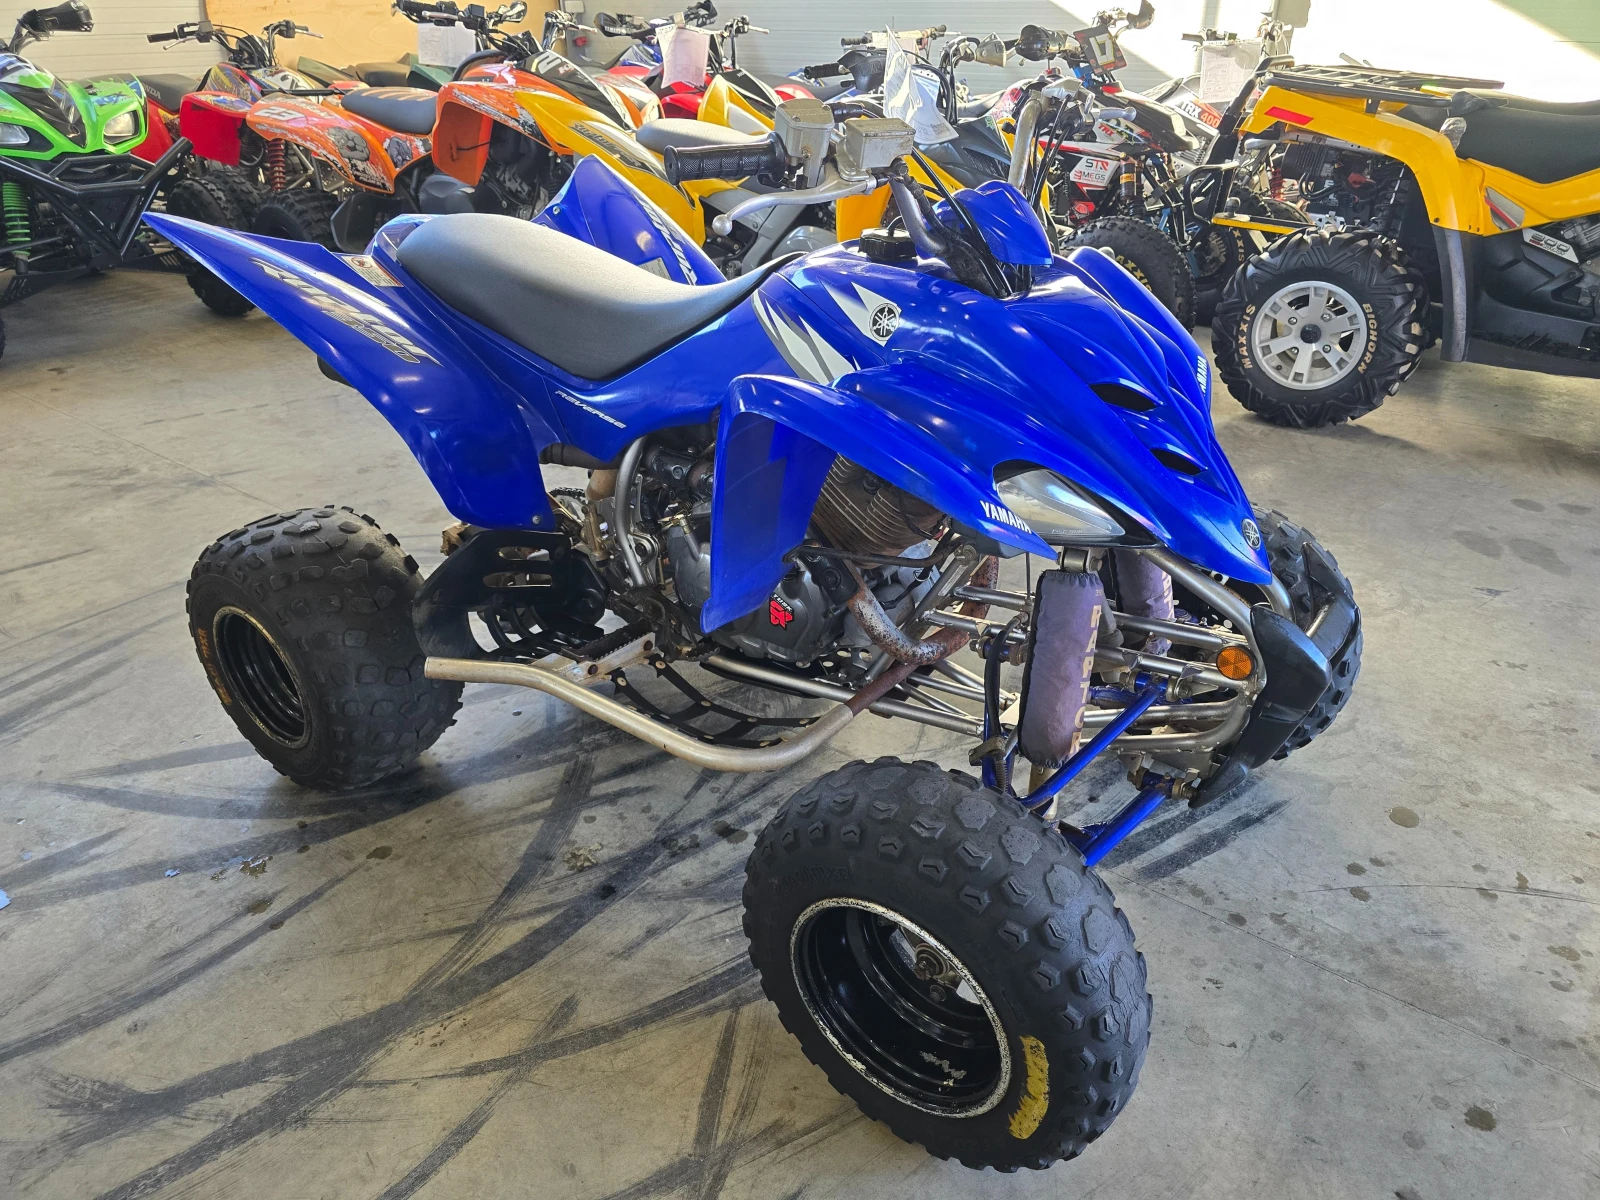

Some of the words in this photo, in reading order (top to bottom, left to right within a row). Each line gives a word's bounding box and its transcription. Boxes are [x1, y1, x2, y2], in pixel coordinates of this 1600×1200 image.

[1097, 123, 1115, 137] TRX
[1200, 112, 1221, 129] 400
[1082, 170, 1106, 181] MEGS
[1238, 303, 1257, 370] MAXXIS
[1356, 302, 1378, 375] BIGHORN
[1196, 355, 1208, 394] AMAHA
[554, 390, 628, 430] REVERSE
[979, 500, 1032, 535] YAMAHA
